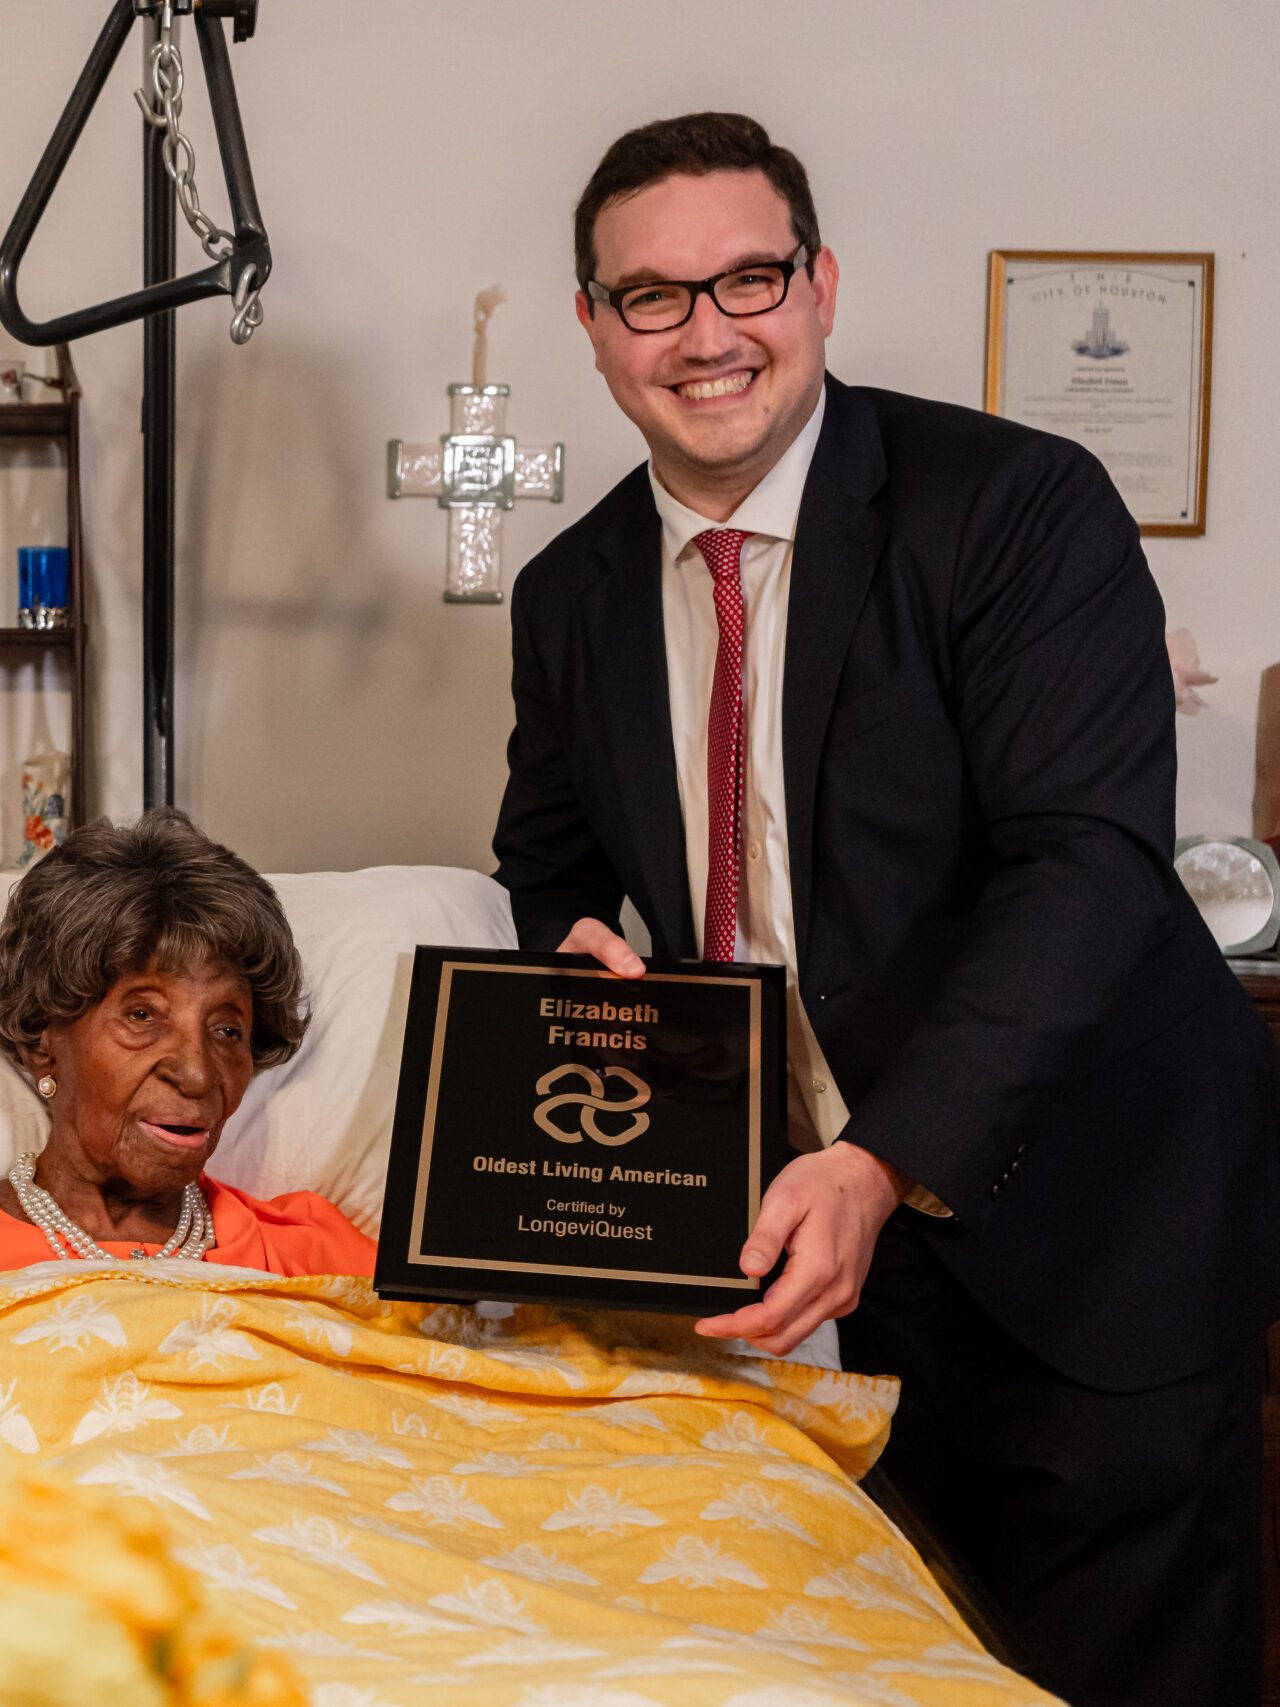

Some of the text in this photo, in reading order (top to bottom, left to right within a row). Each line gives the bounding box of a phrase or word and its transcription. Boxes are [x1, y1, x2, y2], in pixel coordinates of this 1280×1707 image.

[1032, 285, 1167, 304] CITY OF HOUSTON
[539, 998, 659, 1023] Elizabeth
[548, 1025, 647, 1050] Francis
[473, 1156, 707, 1187] Oldest Living American
[546, 1199, 626, 1217] Certified by
[518, 1215, 653, 1240] LongeviQuest
